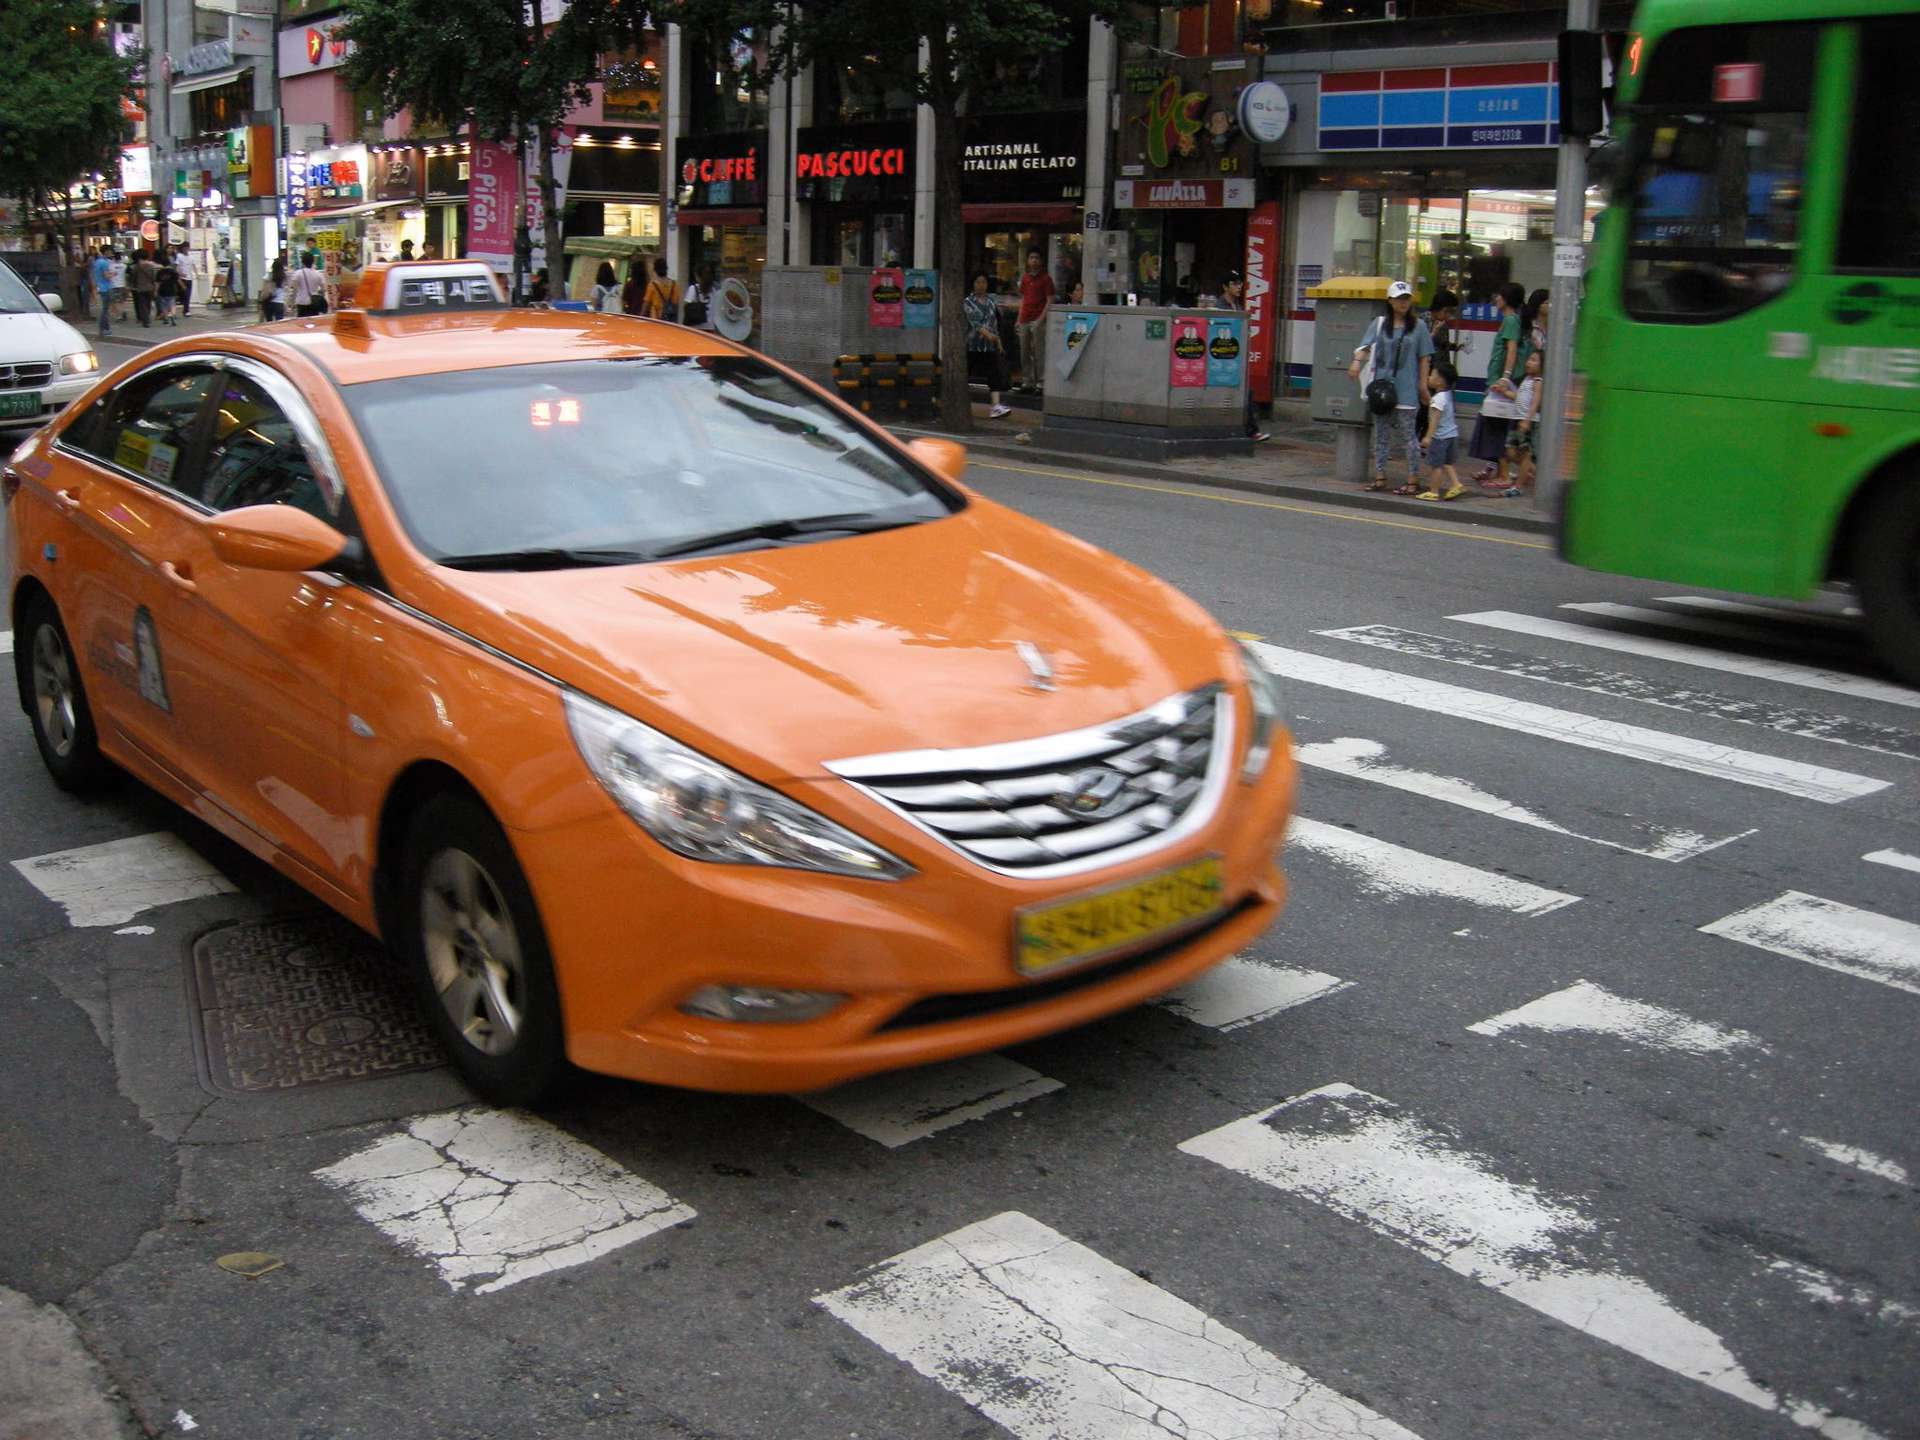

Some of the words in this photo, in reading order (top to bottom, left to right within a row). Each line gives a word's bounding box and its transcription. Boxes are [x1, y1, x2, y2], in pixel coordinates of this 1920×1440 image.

[964, 143, 1041, 157] ARTISANAL
[796, 149, 904, 177] PASCUCCI
[963, 159, 1018, 171] ITALIAN
[1022, 156, 1077, 169] GELATO
[1220, 157, 1238, 171] B1
[1149, 180, 1206, 200] LAVAZZA
[1228, 188, 1239, 199] 2F
[1248, 351, 1260, 362] 2F
